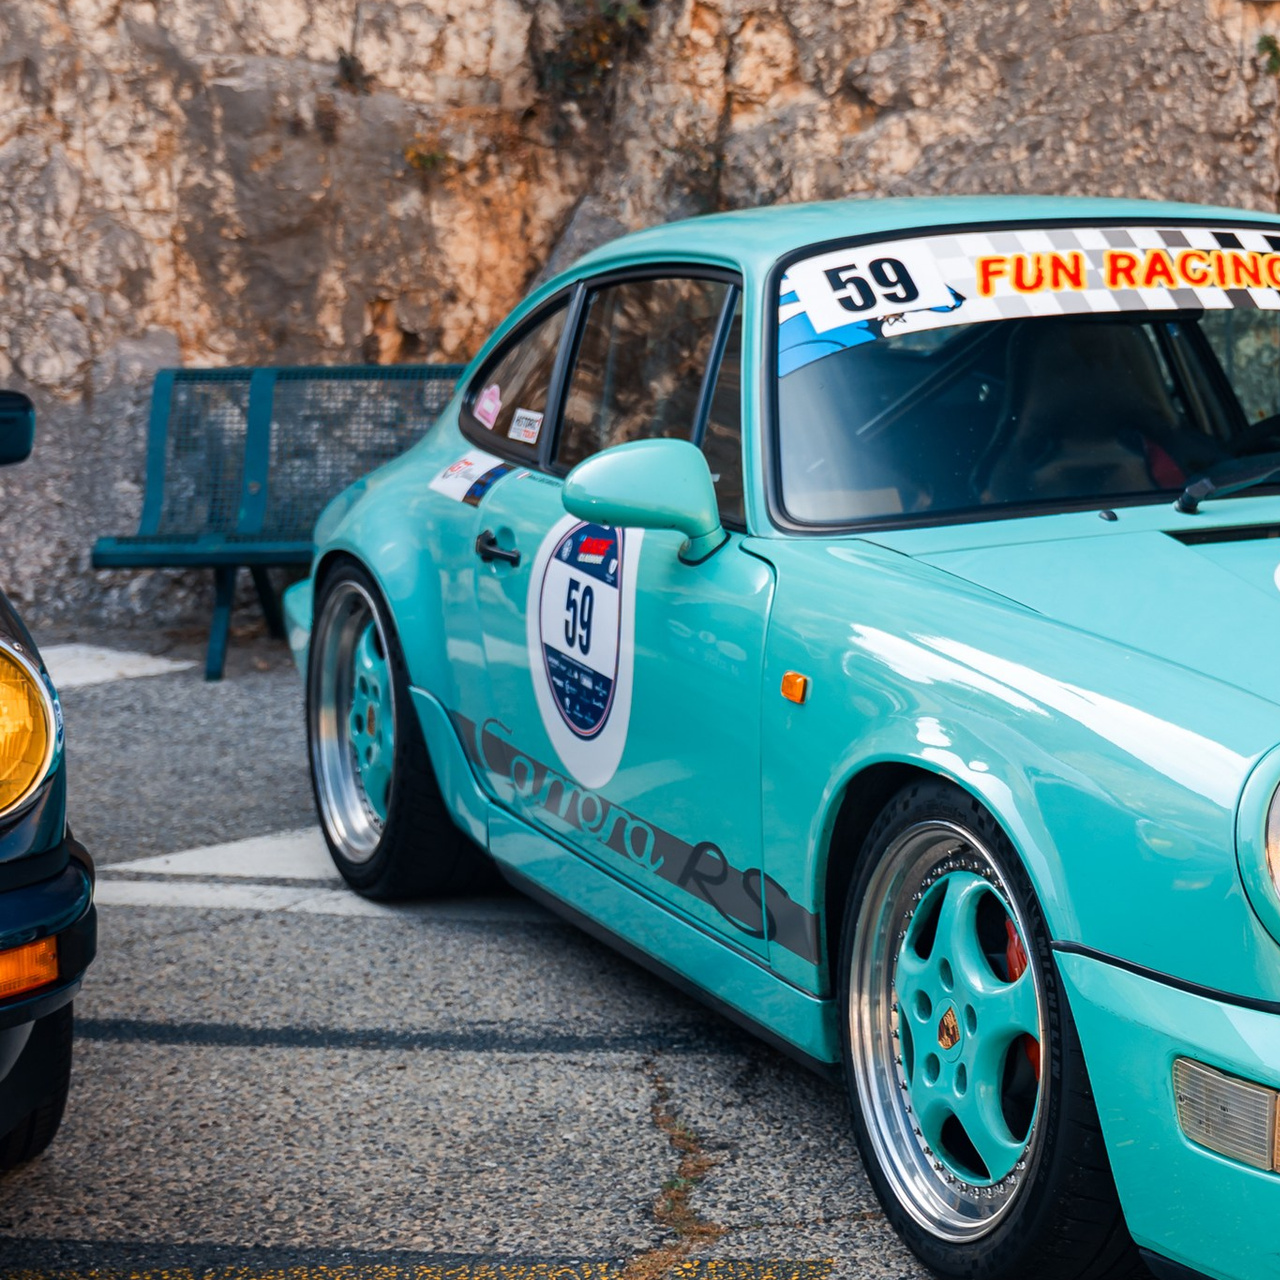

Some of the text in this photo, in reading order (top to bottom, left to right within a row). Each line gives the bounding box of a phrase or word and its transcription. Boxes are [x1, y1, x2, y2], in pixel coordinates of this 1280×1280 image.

[823, 256, 920, 313] 59
[974, 250, 1088, 300] FUN
[563, 577, 595, 656] 59
[677, 840, 790, 942] RS
[1036, 936, 1061, 1080] MICHELIN
